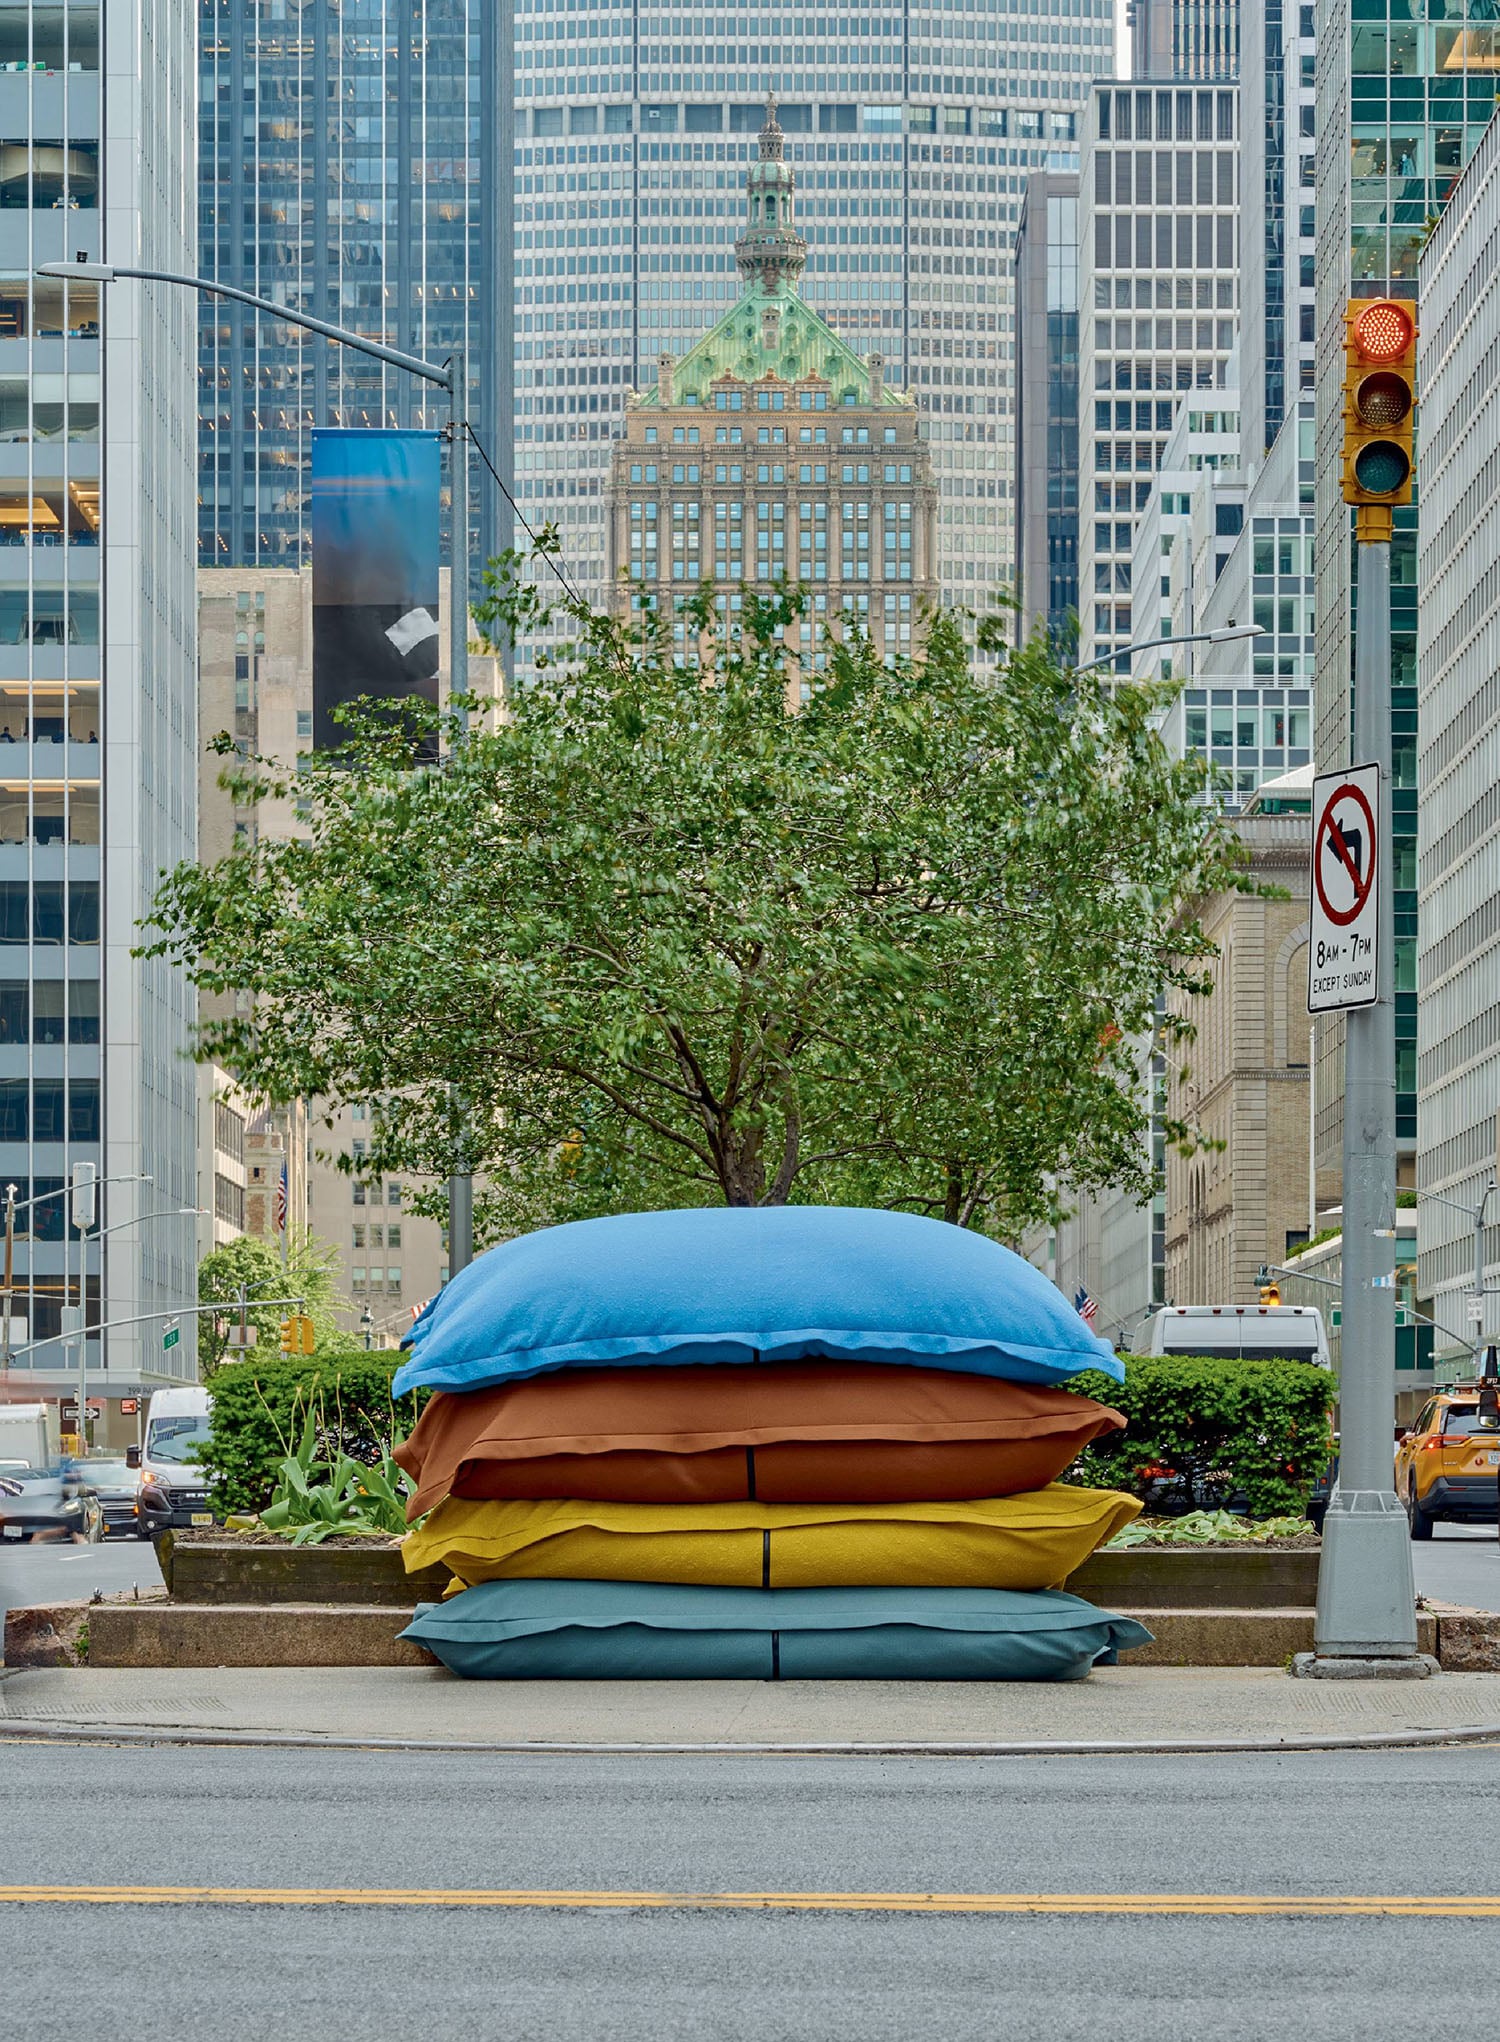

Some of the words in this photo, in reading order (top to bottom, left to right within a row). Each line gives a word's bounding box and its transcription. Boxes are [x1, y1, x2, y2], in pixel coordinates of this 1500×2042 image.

[1316, 940, 1339, 969] 8AM
[1350, 933, 1372, 962] 7PM
[1313, 975, 1341, 994] EXCEPT
[1343, 969, 1372, 989] SUNDAY
